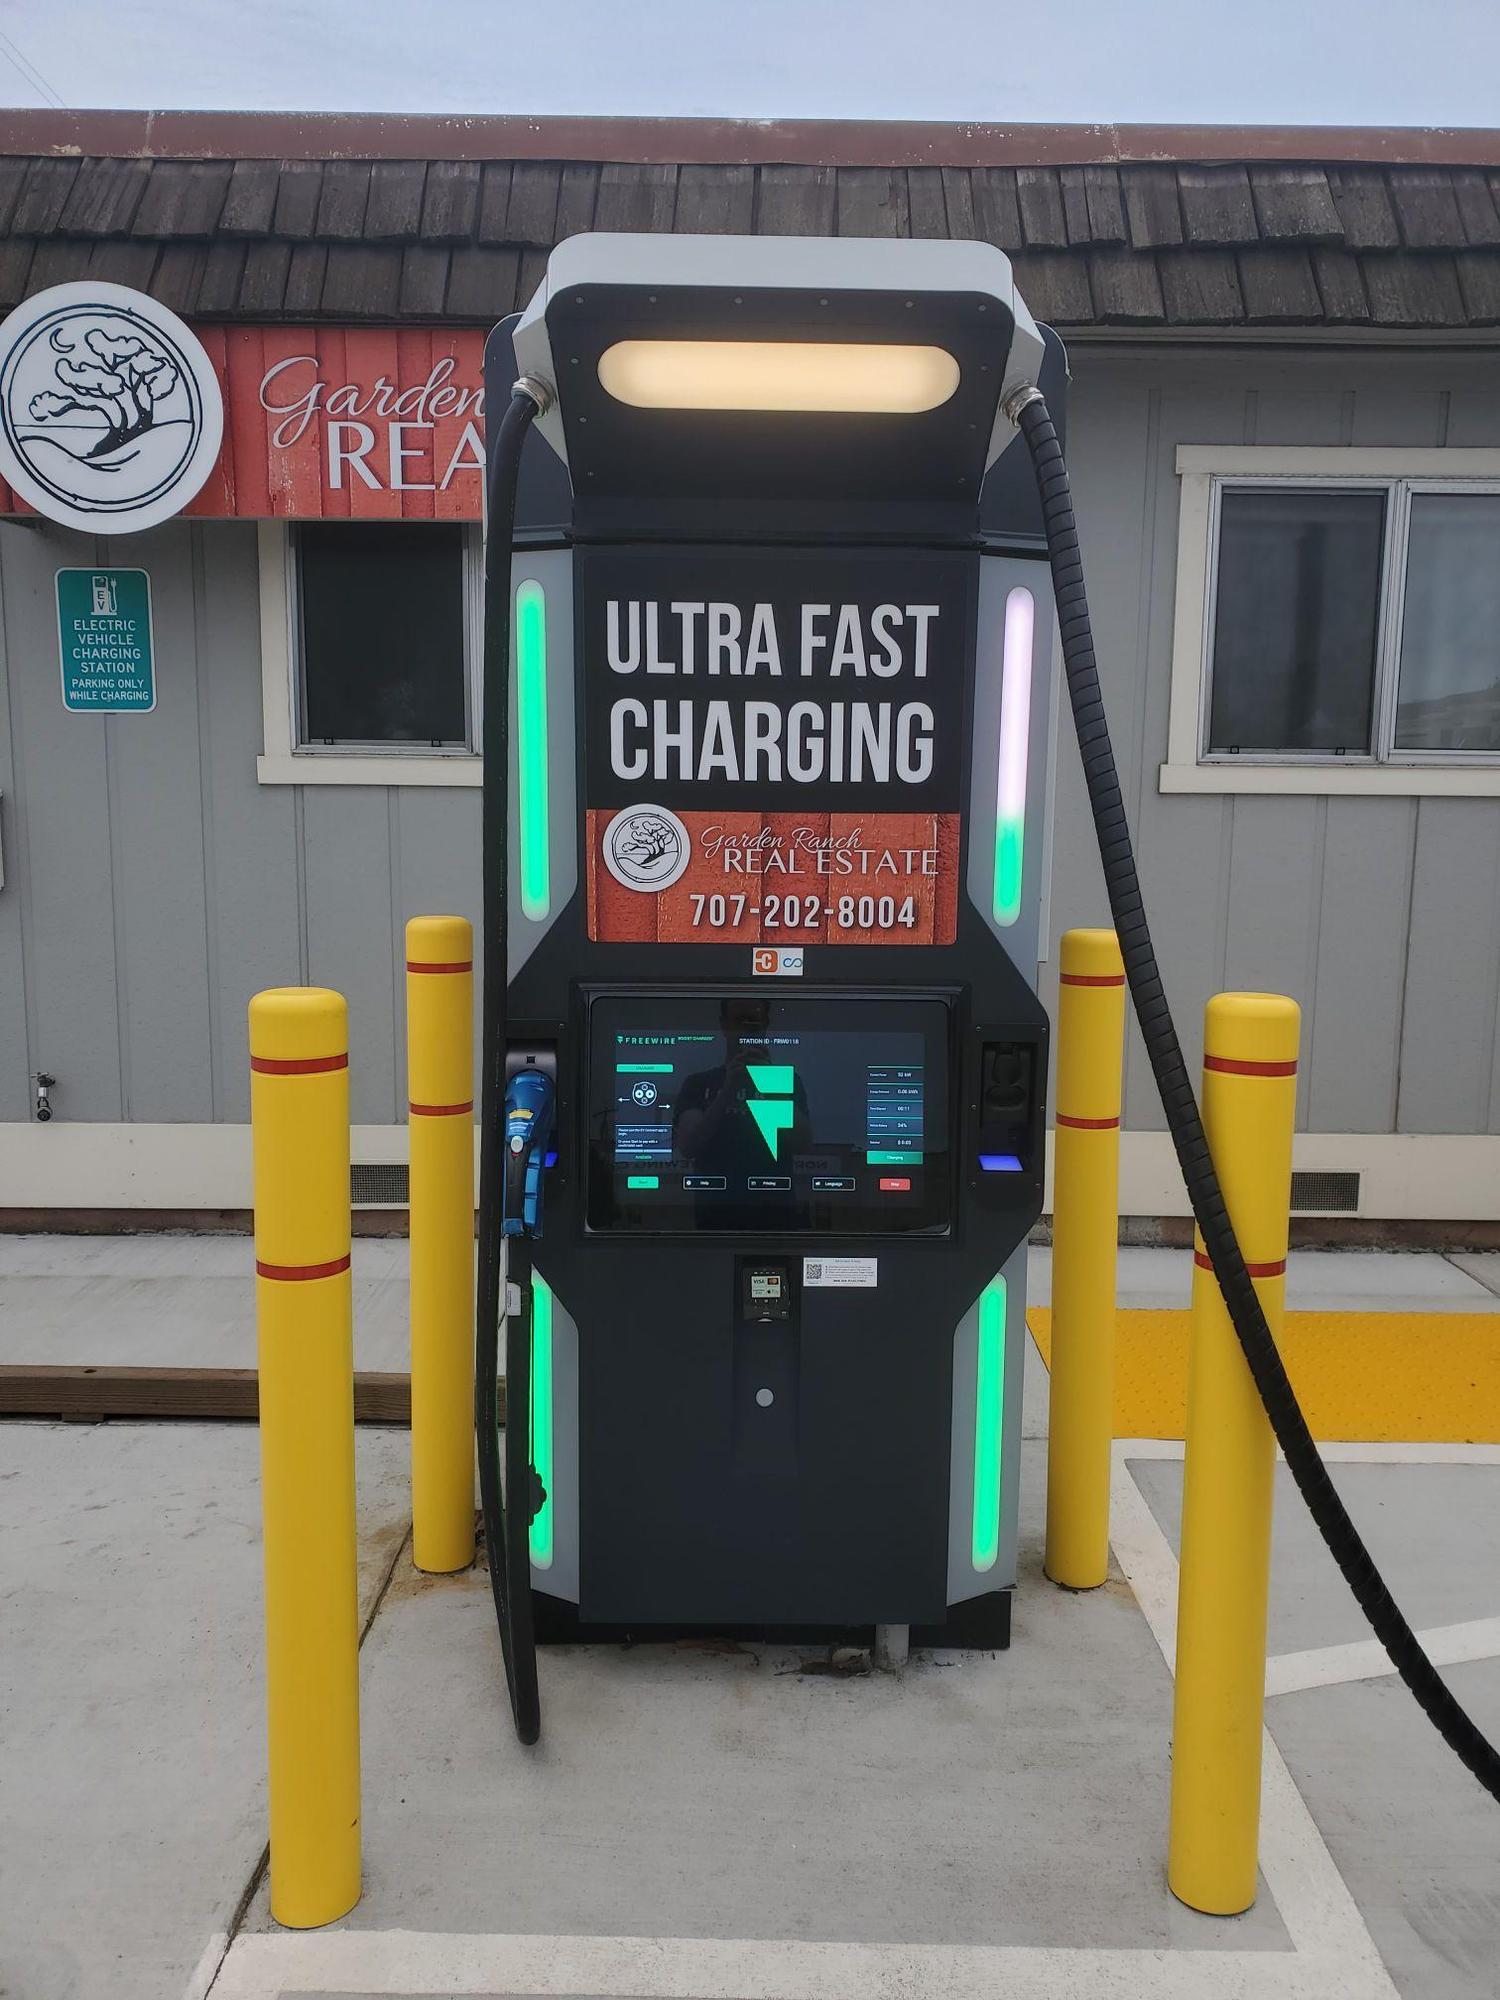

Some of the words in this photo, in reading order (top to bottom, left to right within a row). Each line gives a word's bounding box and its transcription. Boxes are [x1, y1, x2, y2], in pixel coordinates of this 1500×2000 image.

[259, 356, 485, 448] Garden
[327, 421, 487, 490] REA
[73, 619, 136, 631] ELECTRIC
[78, 633, 135, 645] VEHICLE
[606, 600, 782, 676] ULTRA
[800, 603, 940, 678] FAST
[72, 648, 141, 659] CHARGING
[81, 662, 135, 673] STATION
[72, 678, 115, 689] PARKING
[117, 679, 144, 689] ONLY
[70, 690, 98, 701] WHILE
[100, 691, 149, 701] CHARGING
[610, 697, 935, 784] CHARGING
[700, 825, 786, 859] Garden
[791, 826, 863, 854] Ranch
[723, 848, 806, 874] REAL
[817, 849, 940, 876] ESTATE
[689, 893, 915, 929] 707-202-8004
[625, 1036, 676, 1045] FREEWIRE
